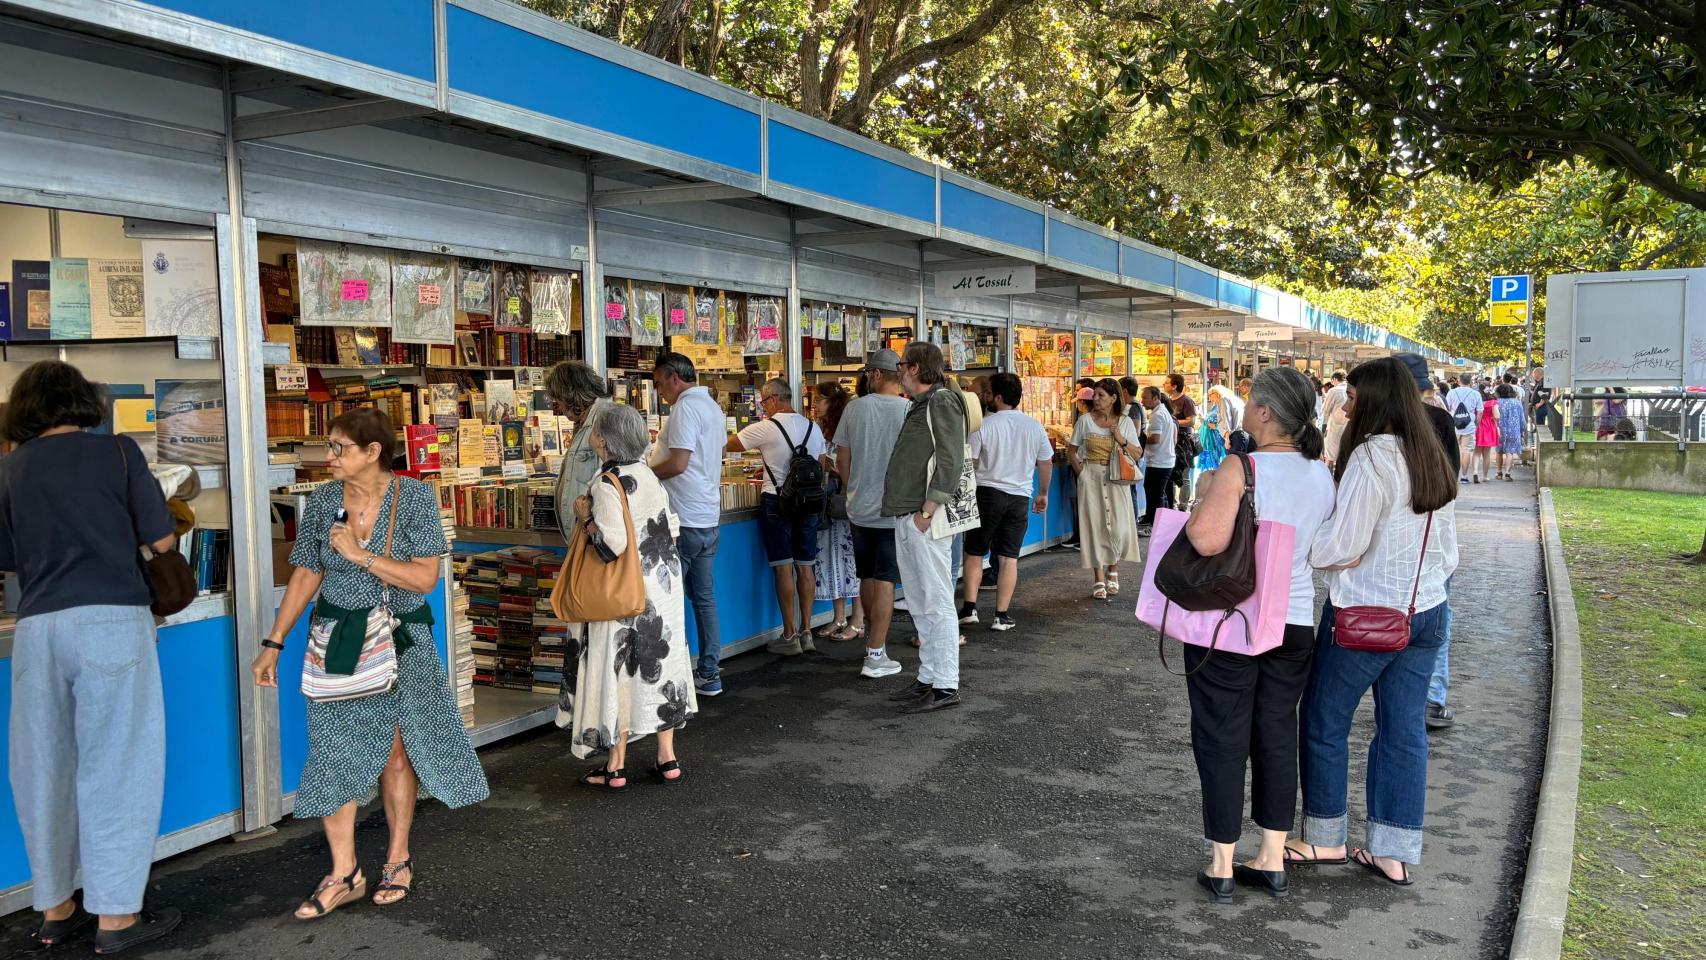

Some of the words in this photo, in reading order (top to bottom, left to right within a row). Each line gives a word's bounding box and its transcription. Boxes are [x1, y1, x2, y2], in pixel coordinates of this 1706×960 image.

[953, 276, 973, 290] Al
[975, 274, 1012, 288] Tossal
[1501, 279, 1519, 299] P
[1187, 321, 1212, 329] Madrid
[169, 436, 178, 445] A
